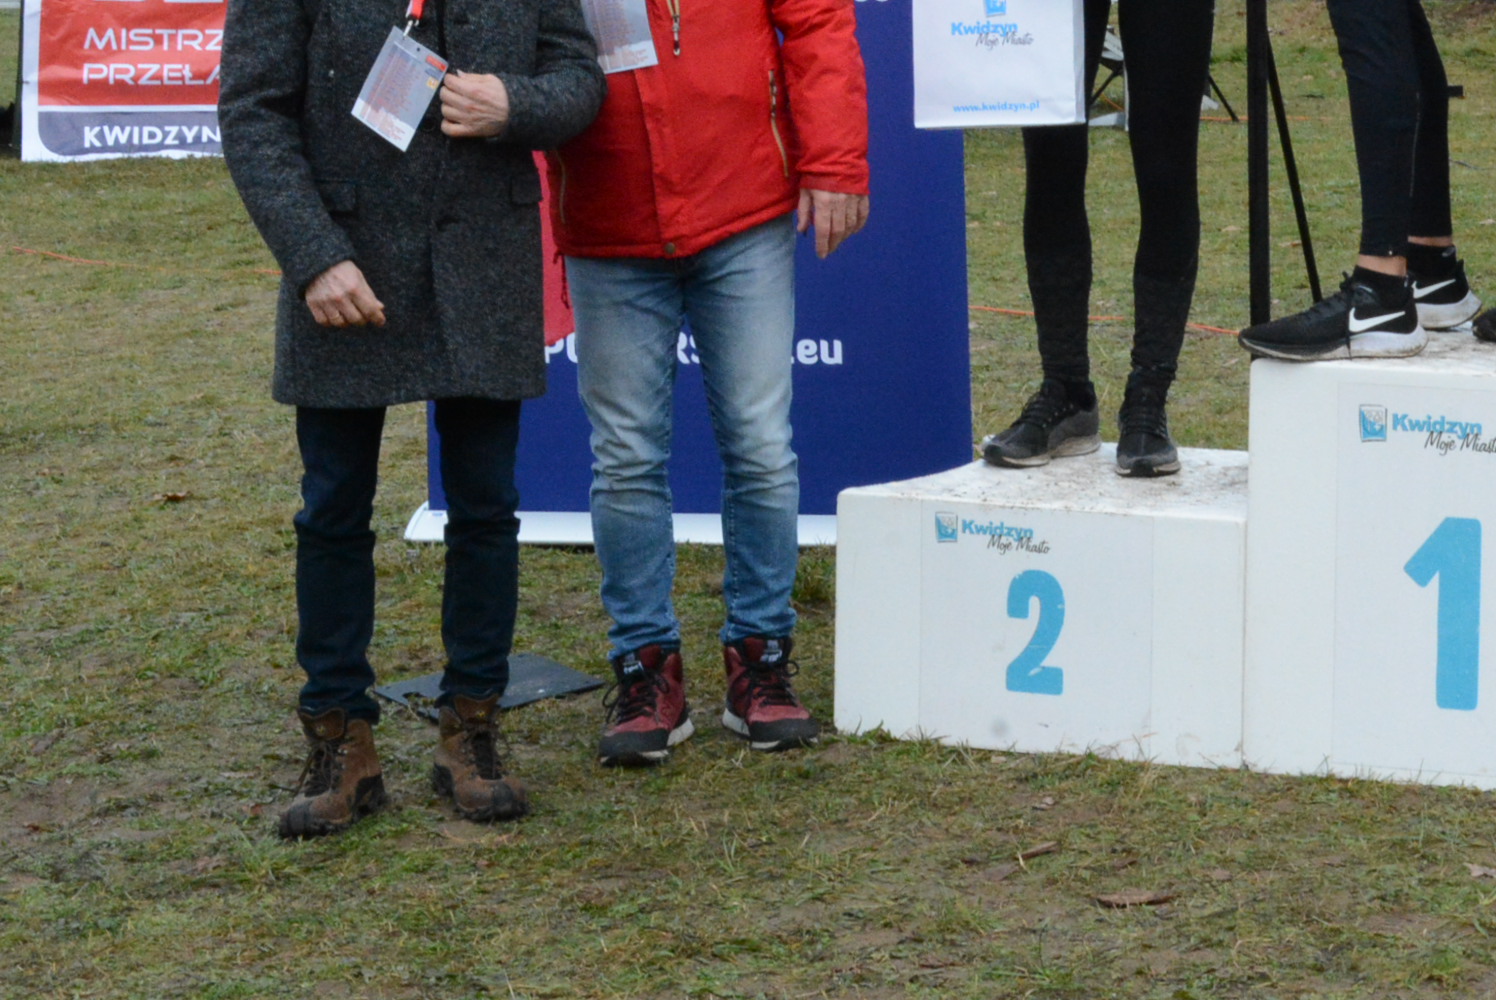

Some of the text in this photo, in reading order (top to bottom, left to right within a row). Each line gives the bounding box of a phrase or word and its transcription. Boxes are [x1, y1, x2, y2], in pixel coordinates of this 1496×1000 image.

[83, 27, 225, 51] MISTRZ
[951, 20, 1018, 37] Kwidzyn
[976, 30, 1035, 51] Moje Miasto
[82, 62, 221, 85] PRZEŁ
[953, 99, 1040, 113] www.kwidzyn.pl
[84, 125, 222, 148] KWIDZYN
[1392, 412, 1483, 437] Kwidzyn
[1424, 431, 1456, 455] Moje
[961, 518, 1034, 541] Kwidzyn
[987, 534, 1051, 555] Moje Miasto
[1403, 516, 1482, 711] 1
[1005, 569, 1065, 695] 2
